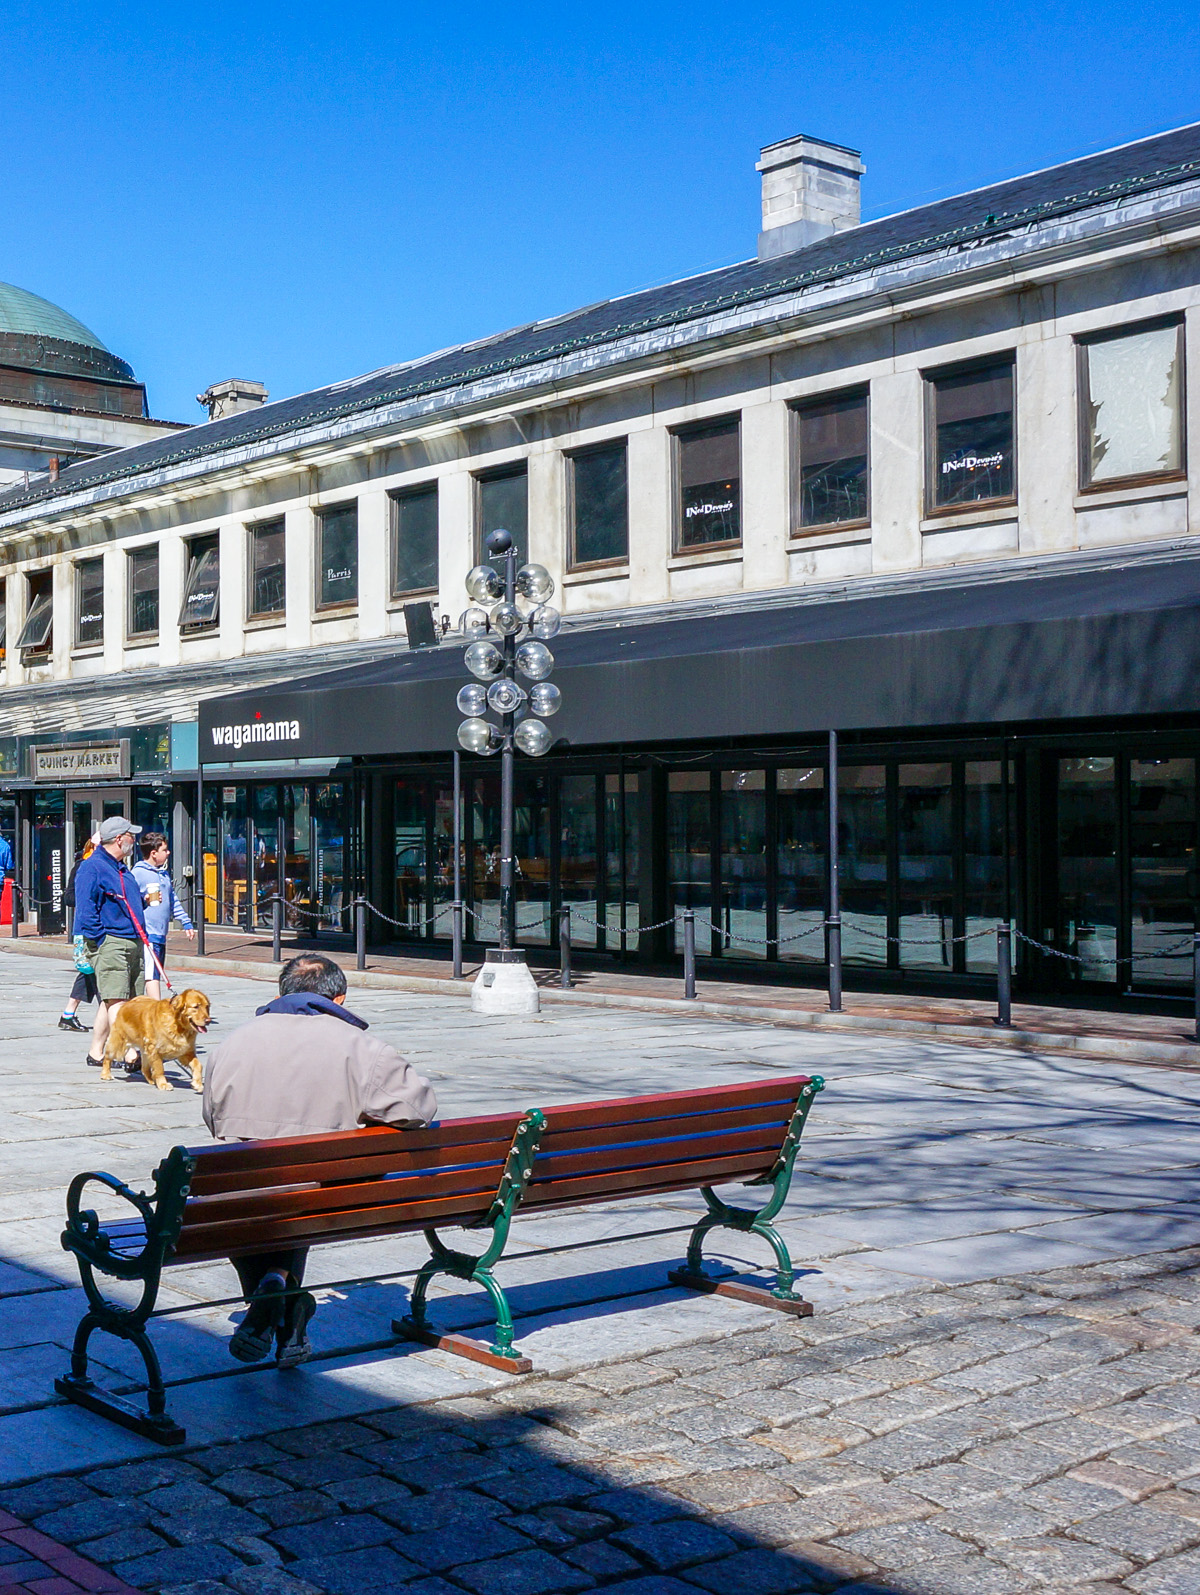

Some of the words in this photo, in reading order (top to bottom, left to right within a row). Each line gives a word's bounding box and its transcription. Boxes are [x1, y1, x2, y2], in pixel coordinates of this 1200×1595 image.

[327, 568, 351, 579] Parris
[212, 720, 300, 749] wagamama
[39, 755, 75, 770] QUINCY
[77, 752, 119, 768] MARKET
[52, 849, 63, 912] wagamama
